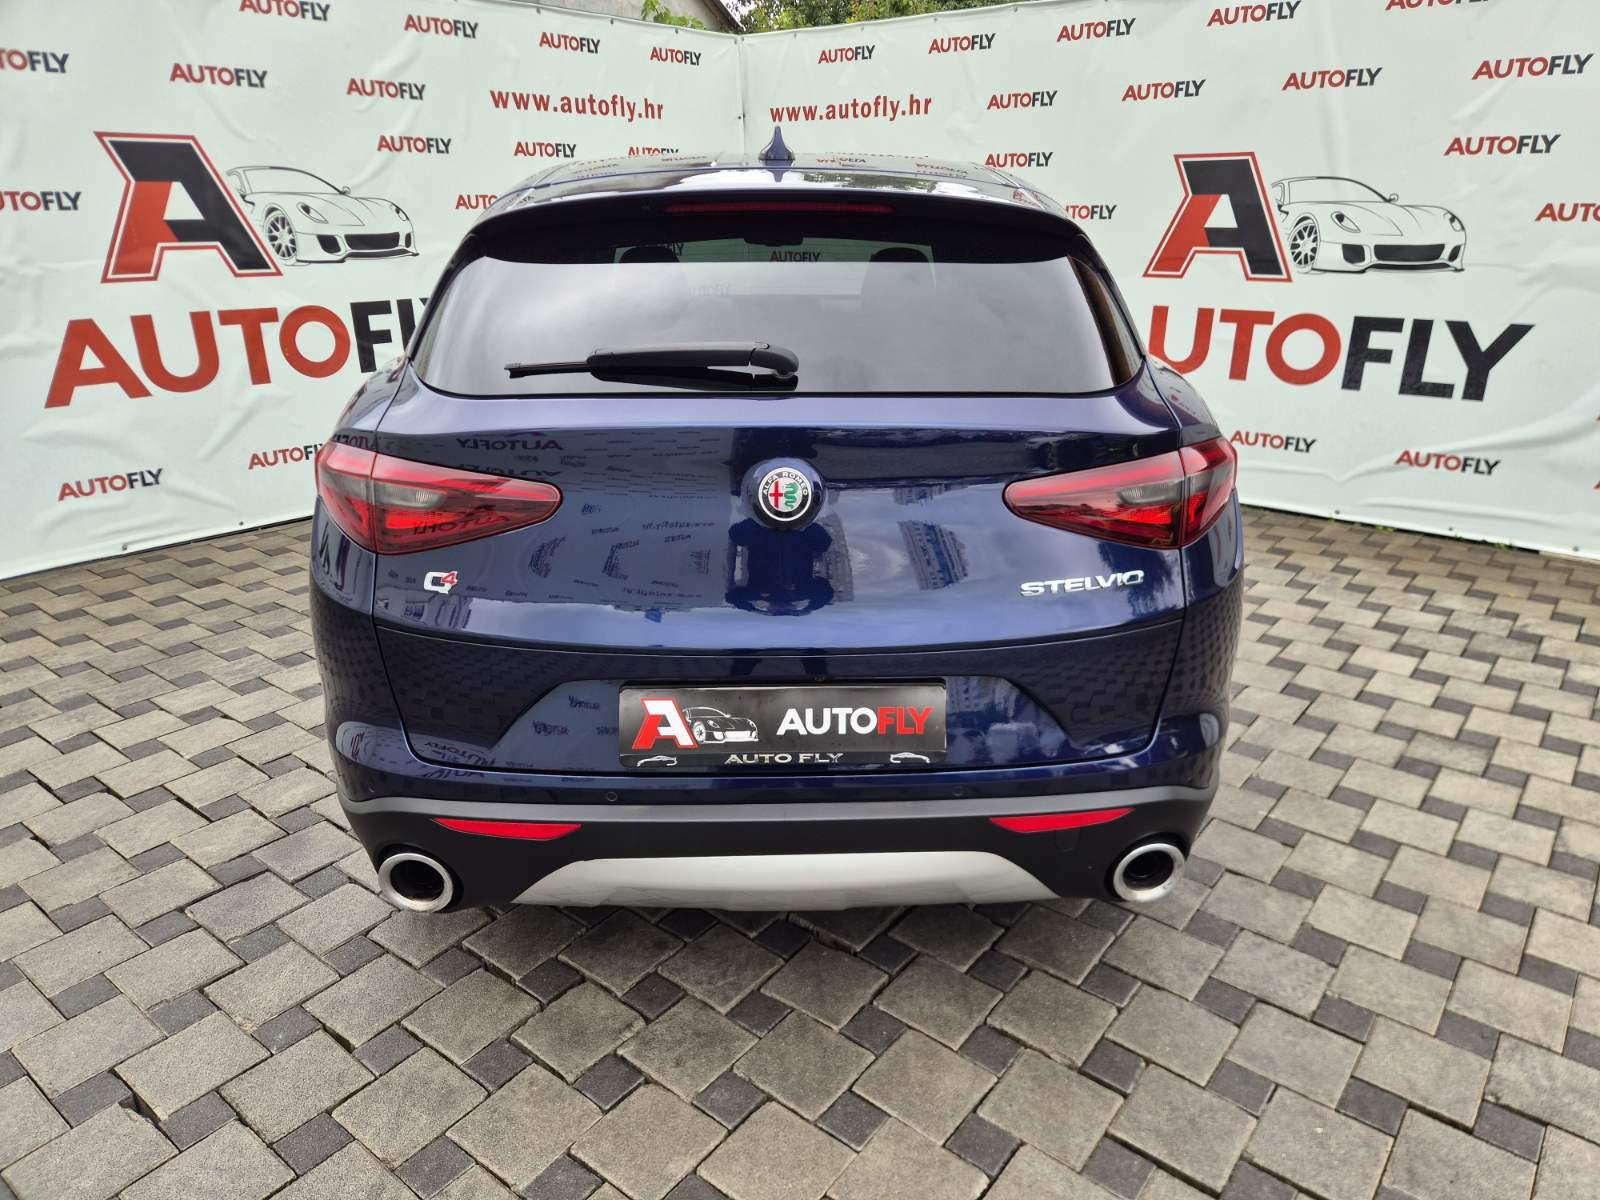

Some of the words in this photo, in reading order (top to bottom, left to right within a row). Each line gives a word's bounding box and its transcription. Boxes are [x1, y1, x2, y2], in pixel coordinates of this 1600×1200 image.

[1207, 1, 1301, 26] AUTOFLY
[404, 15, 479, 38] AUTOFLY
[1057, 18, 1136, 42] AUTOFLY
[539, 32, 600, 54] AUTOFLY
[929, 33, 996, 54] AUTOFLY
[650, 47, 701, 66] AUTOFLY
[818, 45, 875, 64] AUTOFLY
[170, 63, 267, 88] AUTOFLY
[1472, 54, 1593, 80] AUTOFLY
[347, 78, 426, 100] AUTOFLY
[1122, 79, 1206, 101] AUTOFLY
[1282, 67, 1383, 91] AUTOFLY
[490, 89, 664, 122] www.autofly.hr
[770, 94, 932, 122] www.autofly.hr
[987, 90, 1057, 110] AUTOFLY
[378, 135, 452, 154] AUTOFLY
[514, 142, 577, 158] AUTOFLY
[1444, 134, 1561, 156] AUTOFLY
[985, 152, 1053, 168] AUTOFLY
[0, 191, 82, 211] TOFLY
[455, 194, 498, 210] AUTO
[1066, 204, 1117, 220] TOFLY
[1148, 305, 1535, 402] UTOFLY
[1231, 430, 1316, 453] AUTOFLY
[1395, 450, 1501, 476] AUTOFLY
[58, 468, 163, 501] AUTOFLY
[763, 475, 778, 495] ALFA
[782, 471, 808, 496] ROMEO
[1020, 570, 1144, 597] STELVIO
[776, 706, 933, 736] AUTOFLY
[725, 753, 793, 764] AUTO
[799, 753, 844, 764] FLY
